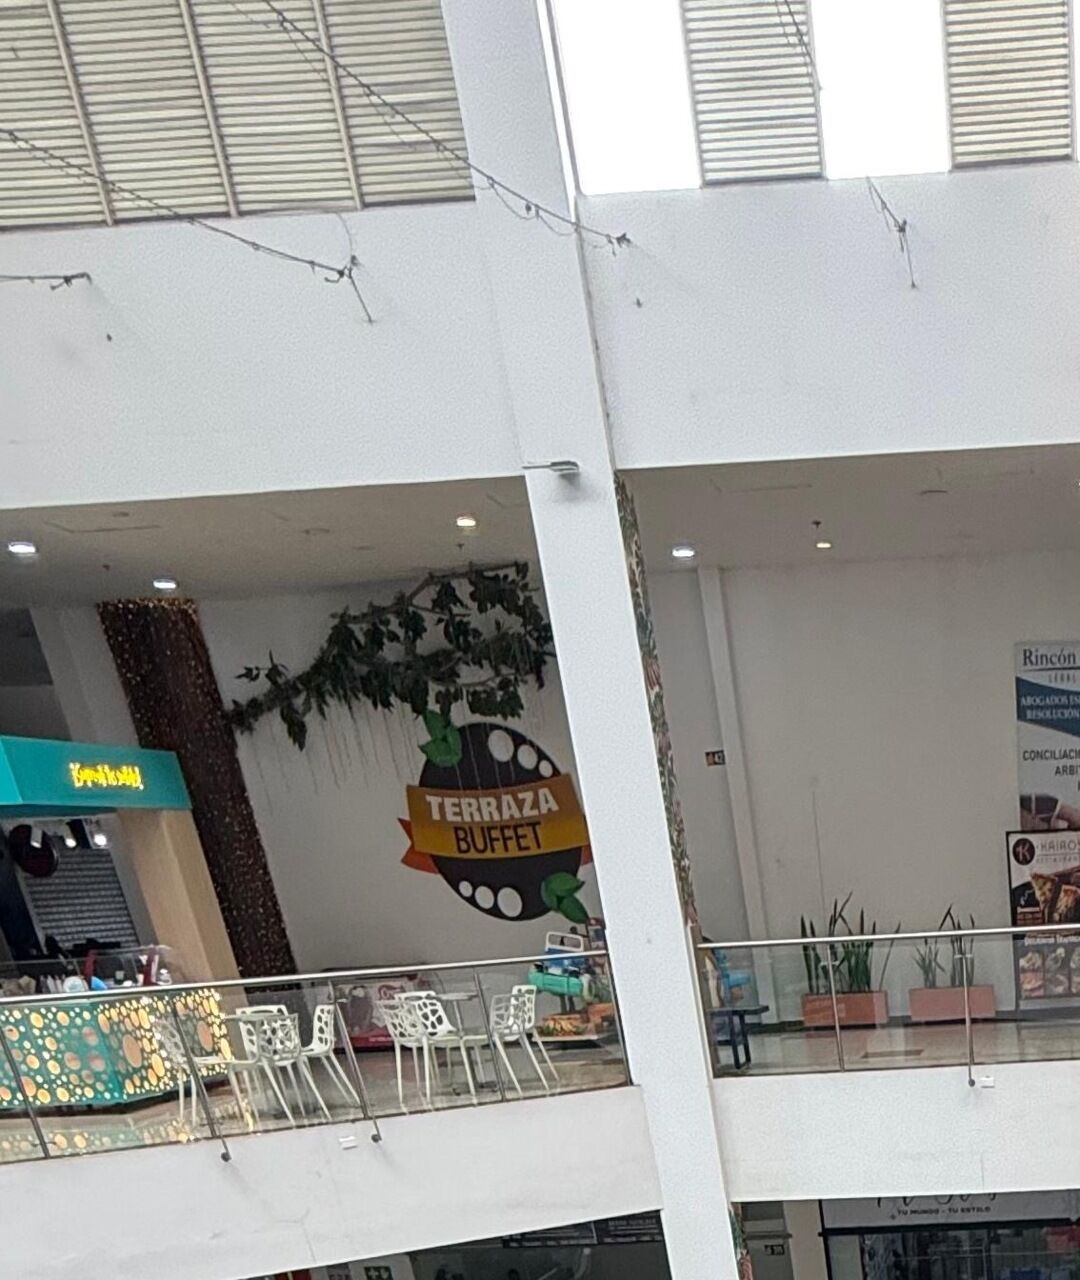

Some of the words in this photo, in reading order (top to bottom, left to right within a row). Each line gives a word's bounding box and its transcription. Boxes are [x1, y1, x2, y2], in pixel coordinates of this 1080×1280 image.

[1023, 647, 1076, 666] Rincón
[425, 787, 559, 822] TERRAZA
[453, 821, 542, 854] BUFFET
